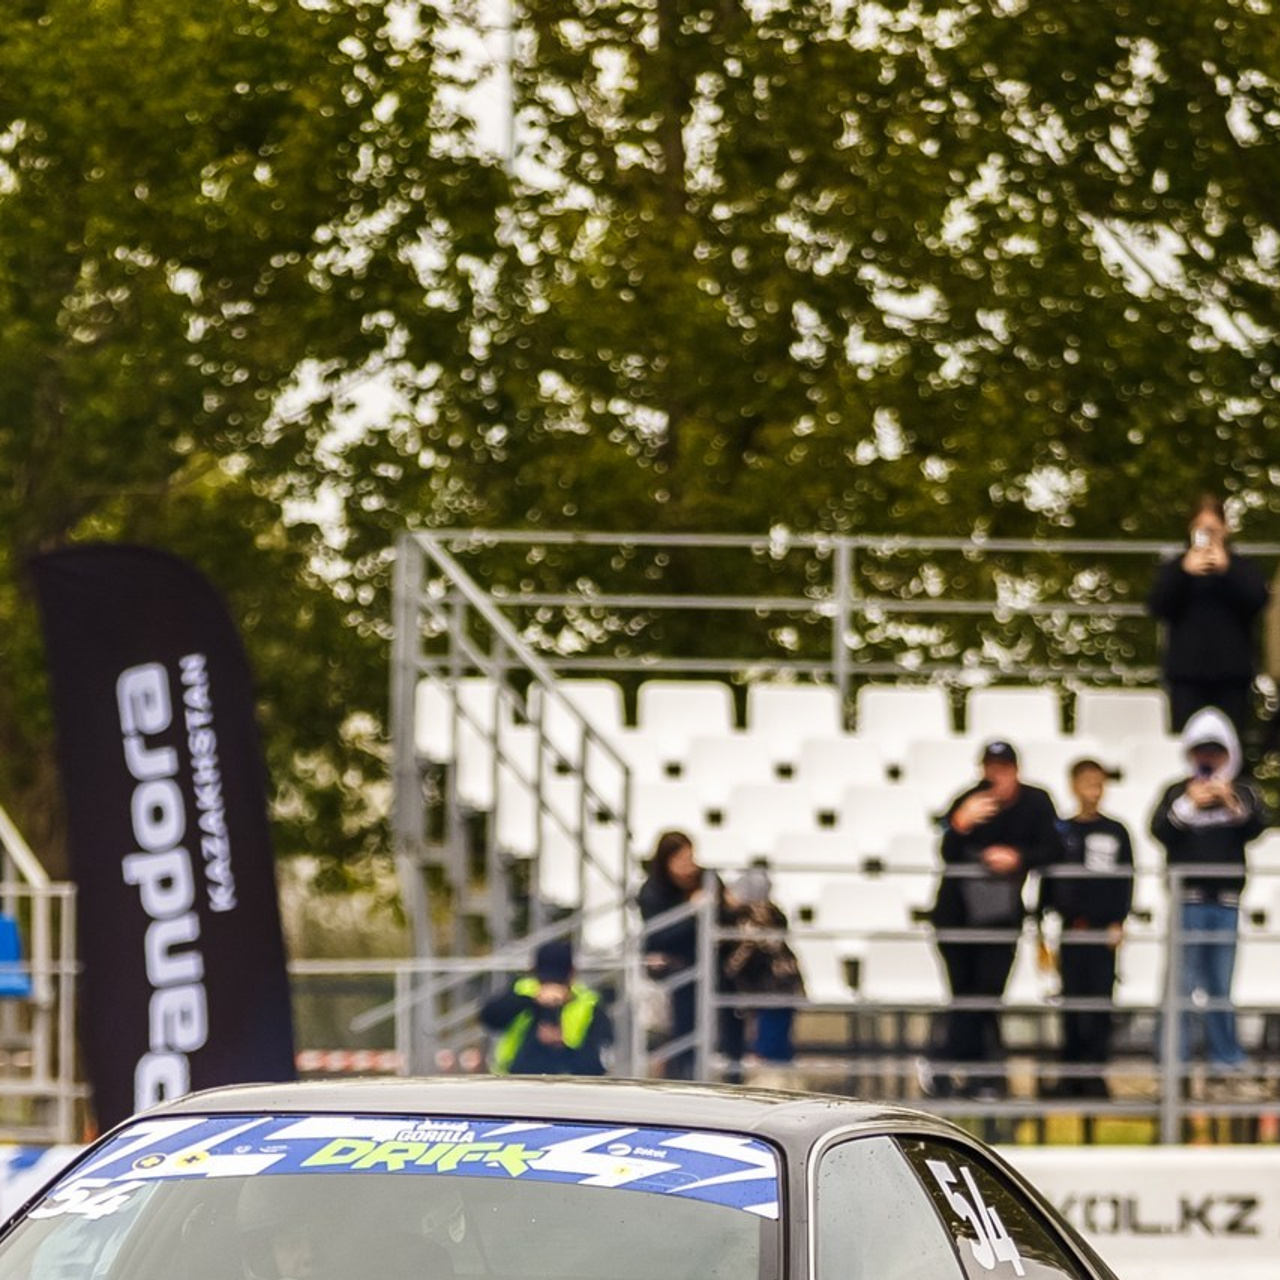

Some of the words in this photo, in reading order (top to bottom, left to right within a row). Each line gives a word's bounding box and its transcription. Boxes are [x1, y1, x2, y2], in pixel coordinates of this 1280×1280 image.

[178, 652, 237, 911] KAZAKHSTAN
[396, 1129, 475, 1143] GORILLA
[28, 1179, 148, 1220] 54
[925, 1160, 1025, 1276] 54
